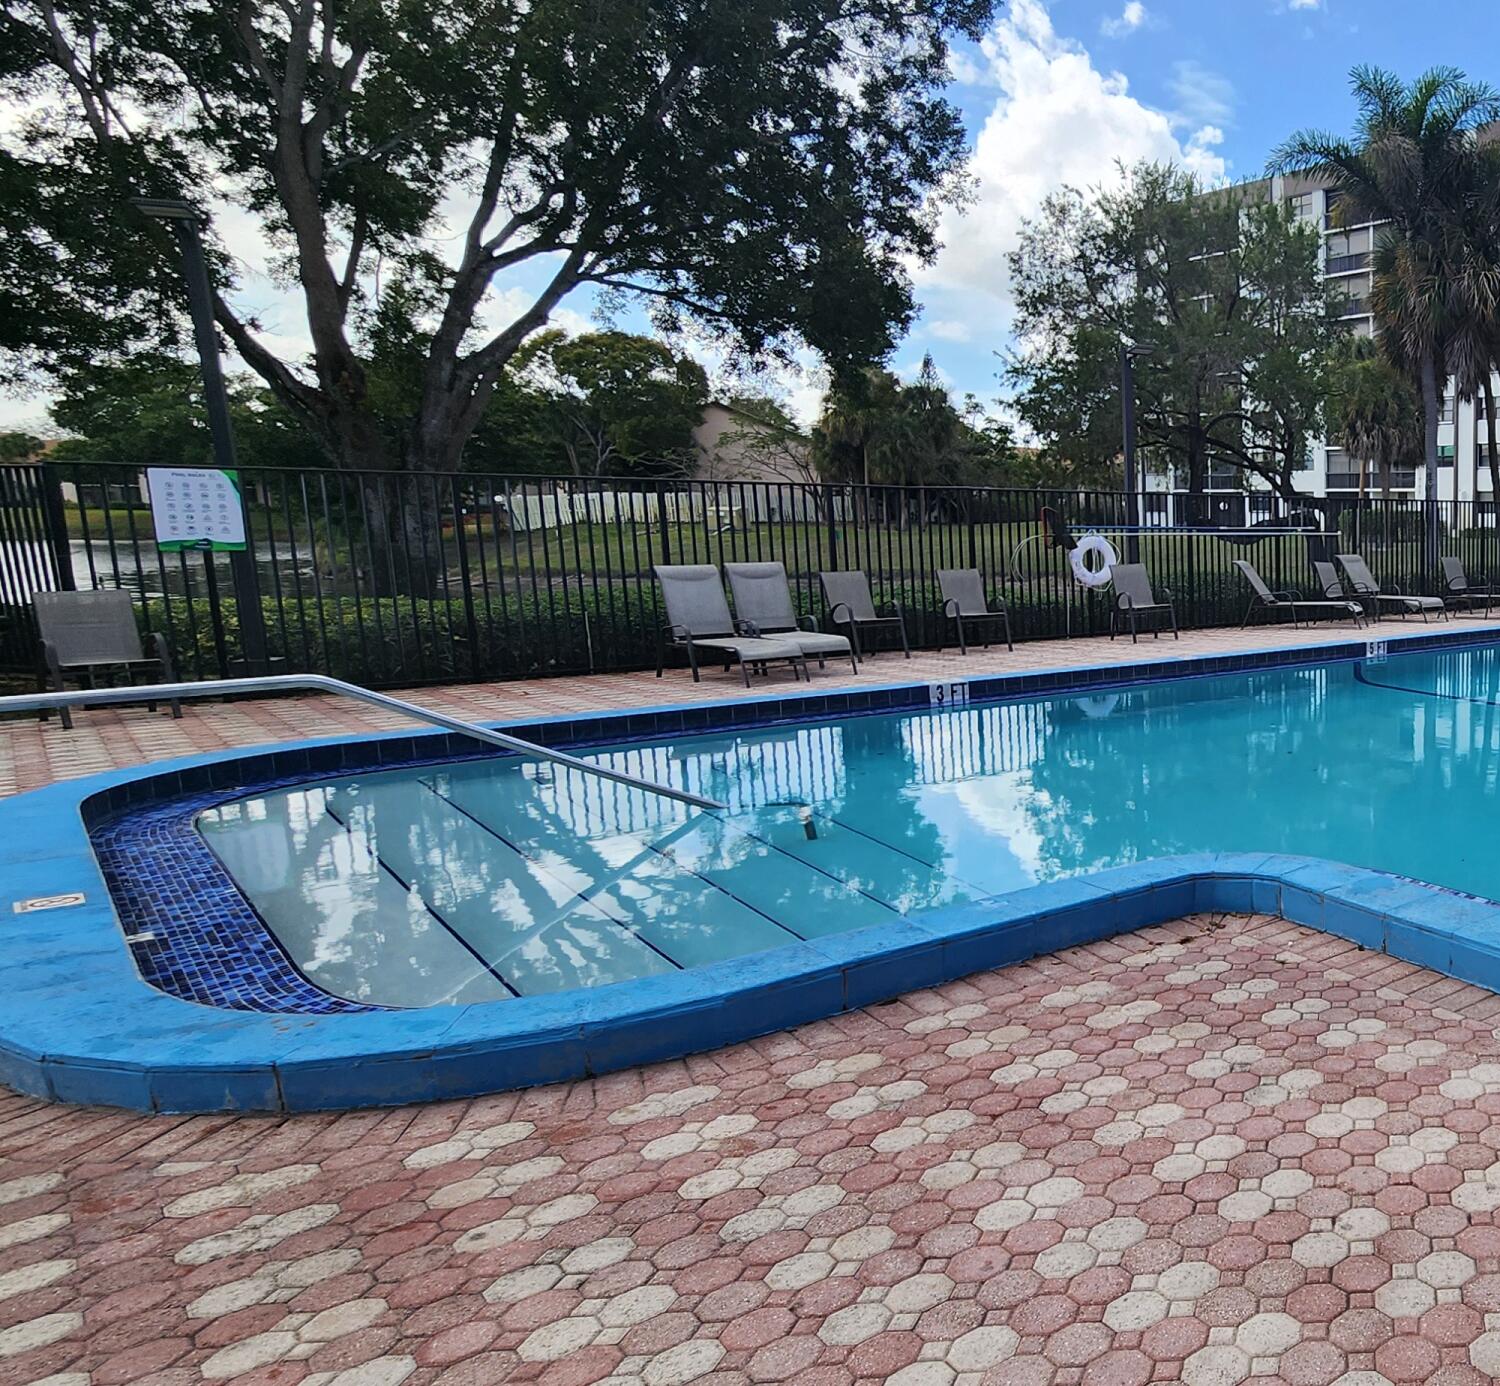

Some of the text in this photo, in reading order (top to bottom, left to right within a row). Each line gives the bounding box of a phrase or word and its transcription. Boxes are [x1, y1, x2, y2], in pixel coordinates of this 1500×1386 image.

[1369, 642, 1374, 655] 5
[936, 682, 968, 705] 3 FT
